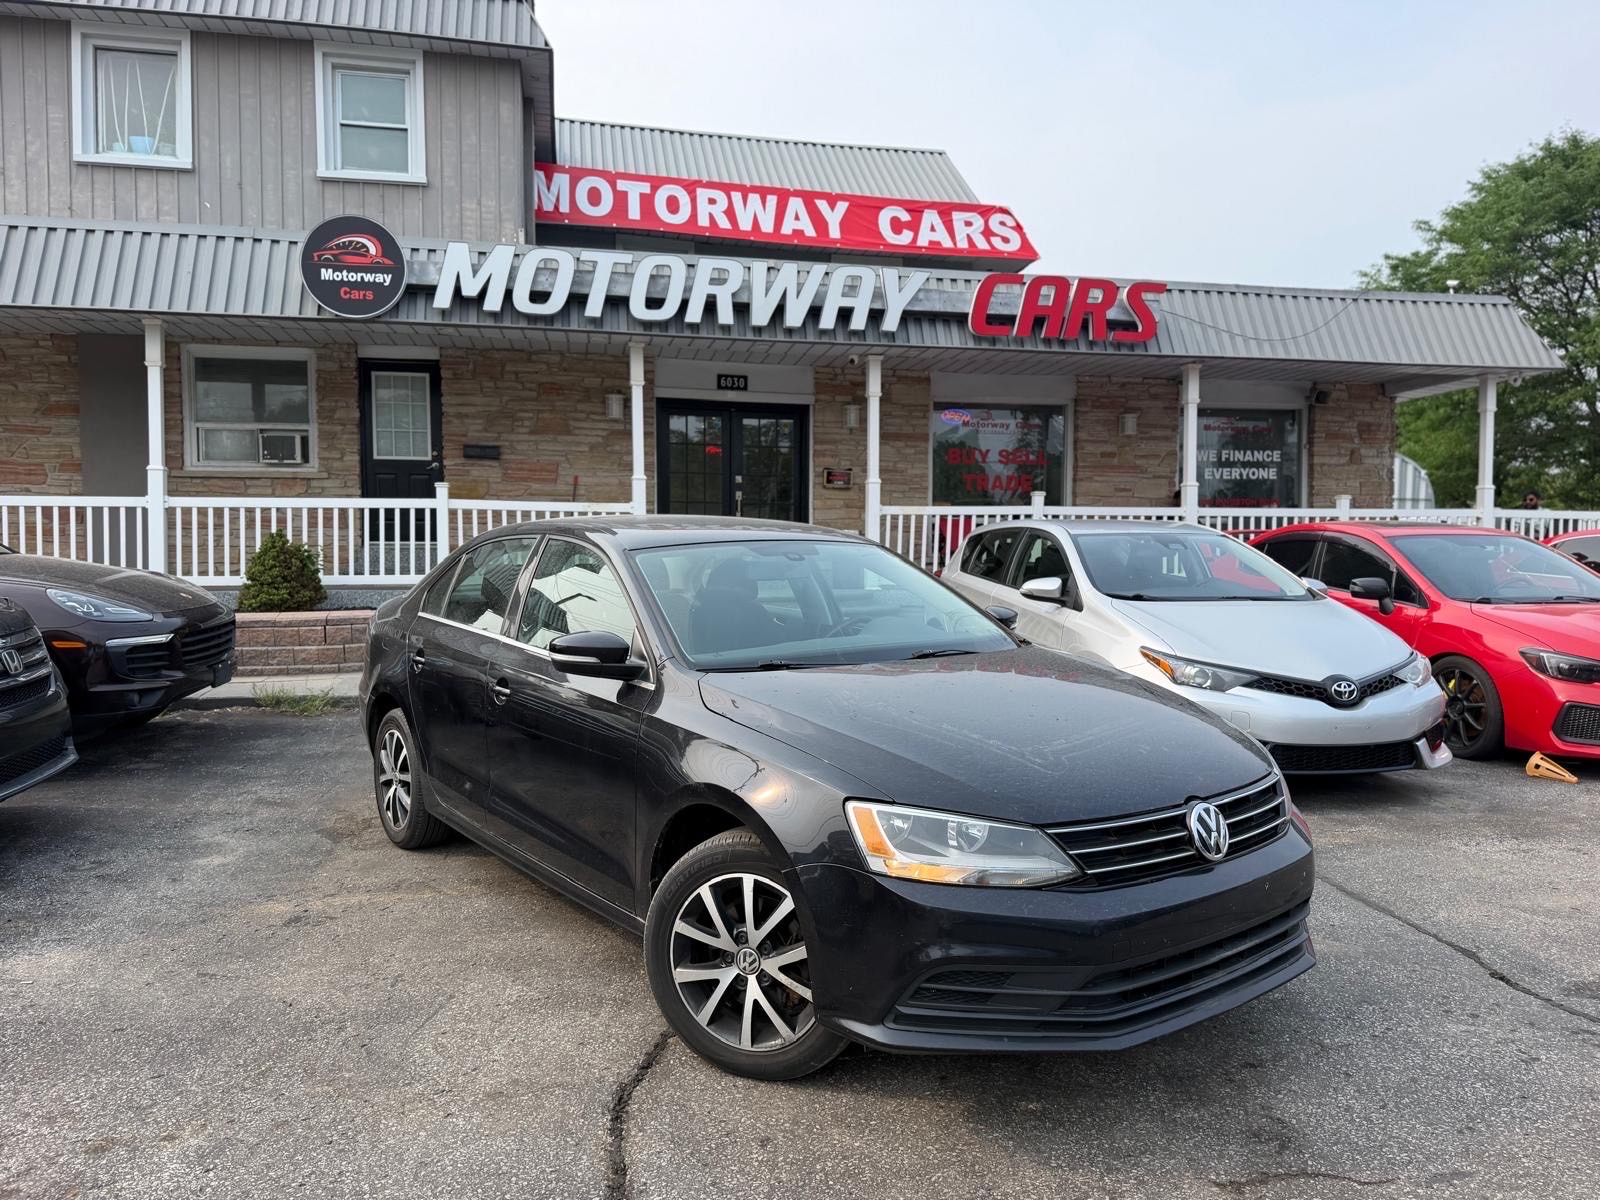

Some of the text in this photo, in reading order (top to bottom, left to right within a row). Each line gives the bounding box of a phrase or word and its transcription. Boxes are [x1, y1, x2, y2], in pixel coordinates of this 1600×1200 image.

[535, 170, 1022, 252] MOTORWAY CARS
[320, 268, 392, 286] Motorway
[340, 287, 374, 300] Cars
[432, 242, 1168, 343] MOTORWAY CARS
[720, 376, 745, 388] 6030
[962, 420, 1010, 431] Motorway
[947, 448, 990, 465] BUY
[1197, 450, 1281, 462] WE FINANCE
[1204, 468, 1278, 479] EVERYONE
[963, 473, 1033, 492] TRADE
